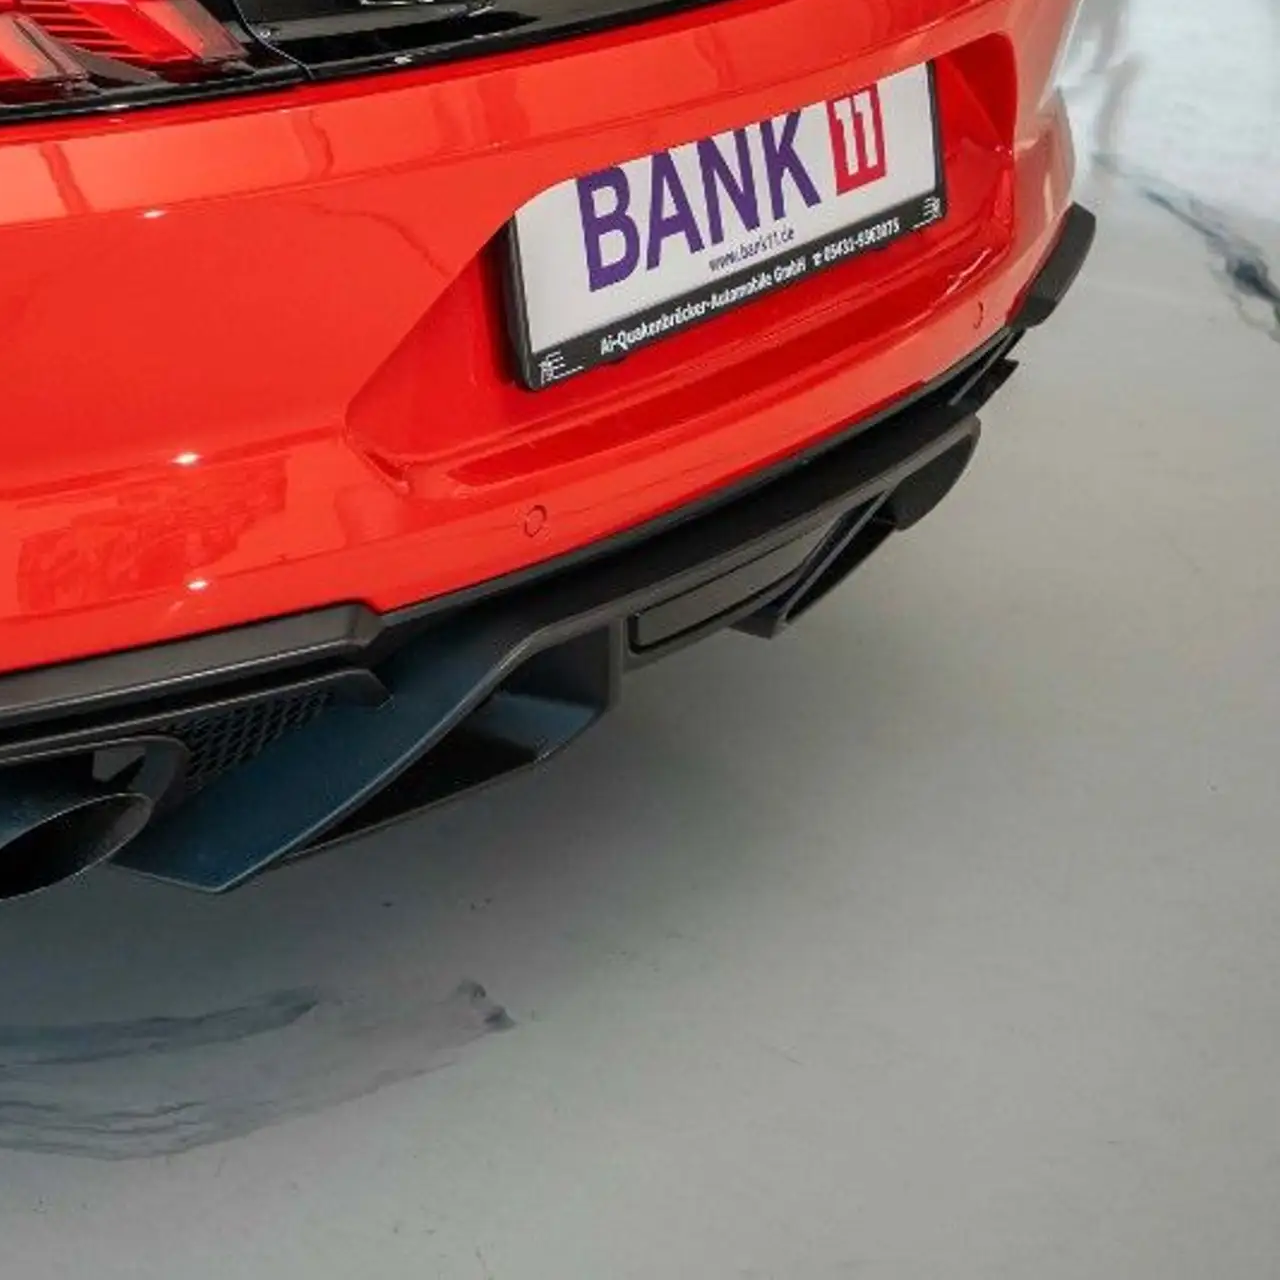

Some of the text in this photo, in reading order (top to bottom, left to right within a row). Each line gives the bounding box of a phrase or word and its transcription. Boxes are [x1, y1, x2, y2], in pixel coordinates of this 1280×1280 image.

[577, 87, 881, 293] BANK 11
[708, 223, 795, 272] www.bank11.de
[773, 255, 806, 282] GmbH
